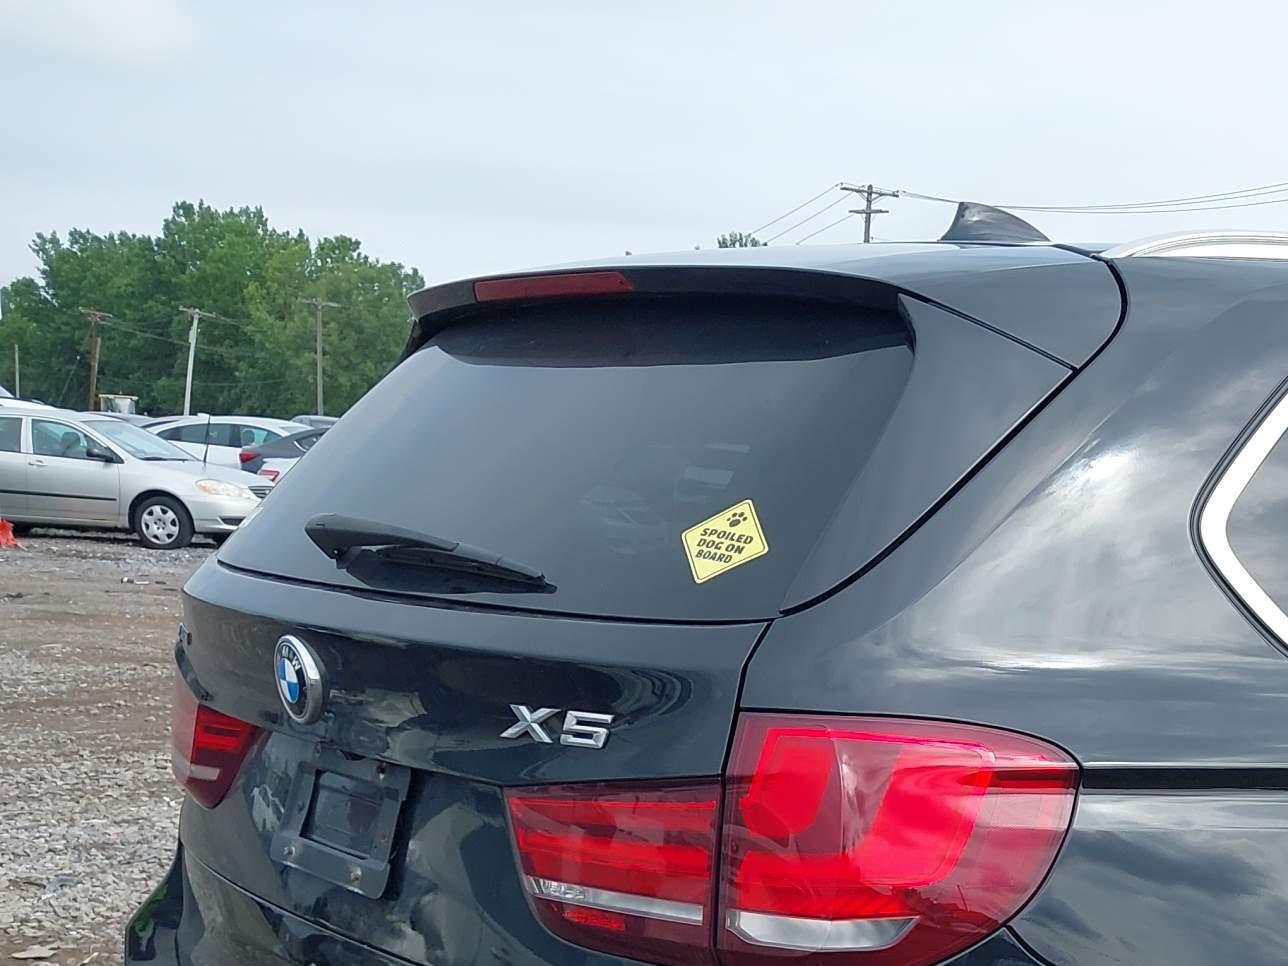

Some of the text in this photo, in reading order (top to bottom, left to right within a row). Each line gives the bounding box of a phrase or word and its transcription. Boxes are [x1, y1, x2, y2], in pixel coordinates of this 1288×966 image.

[700, 528, 754, 545] SPOILED
[696, 538, 746, 555] DOG ON
[695, 549, 733, 564] BOARD
[499, 703, 616, 749] X5
